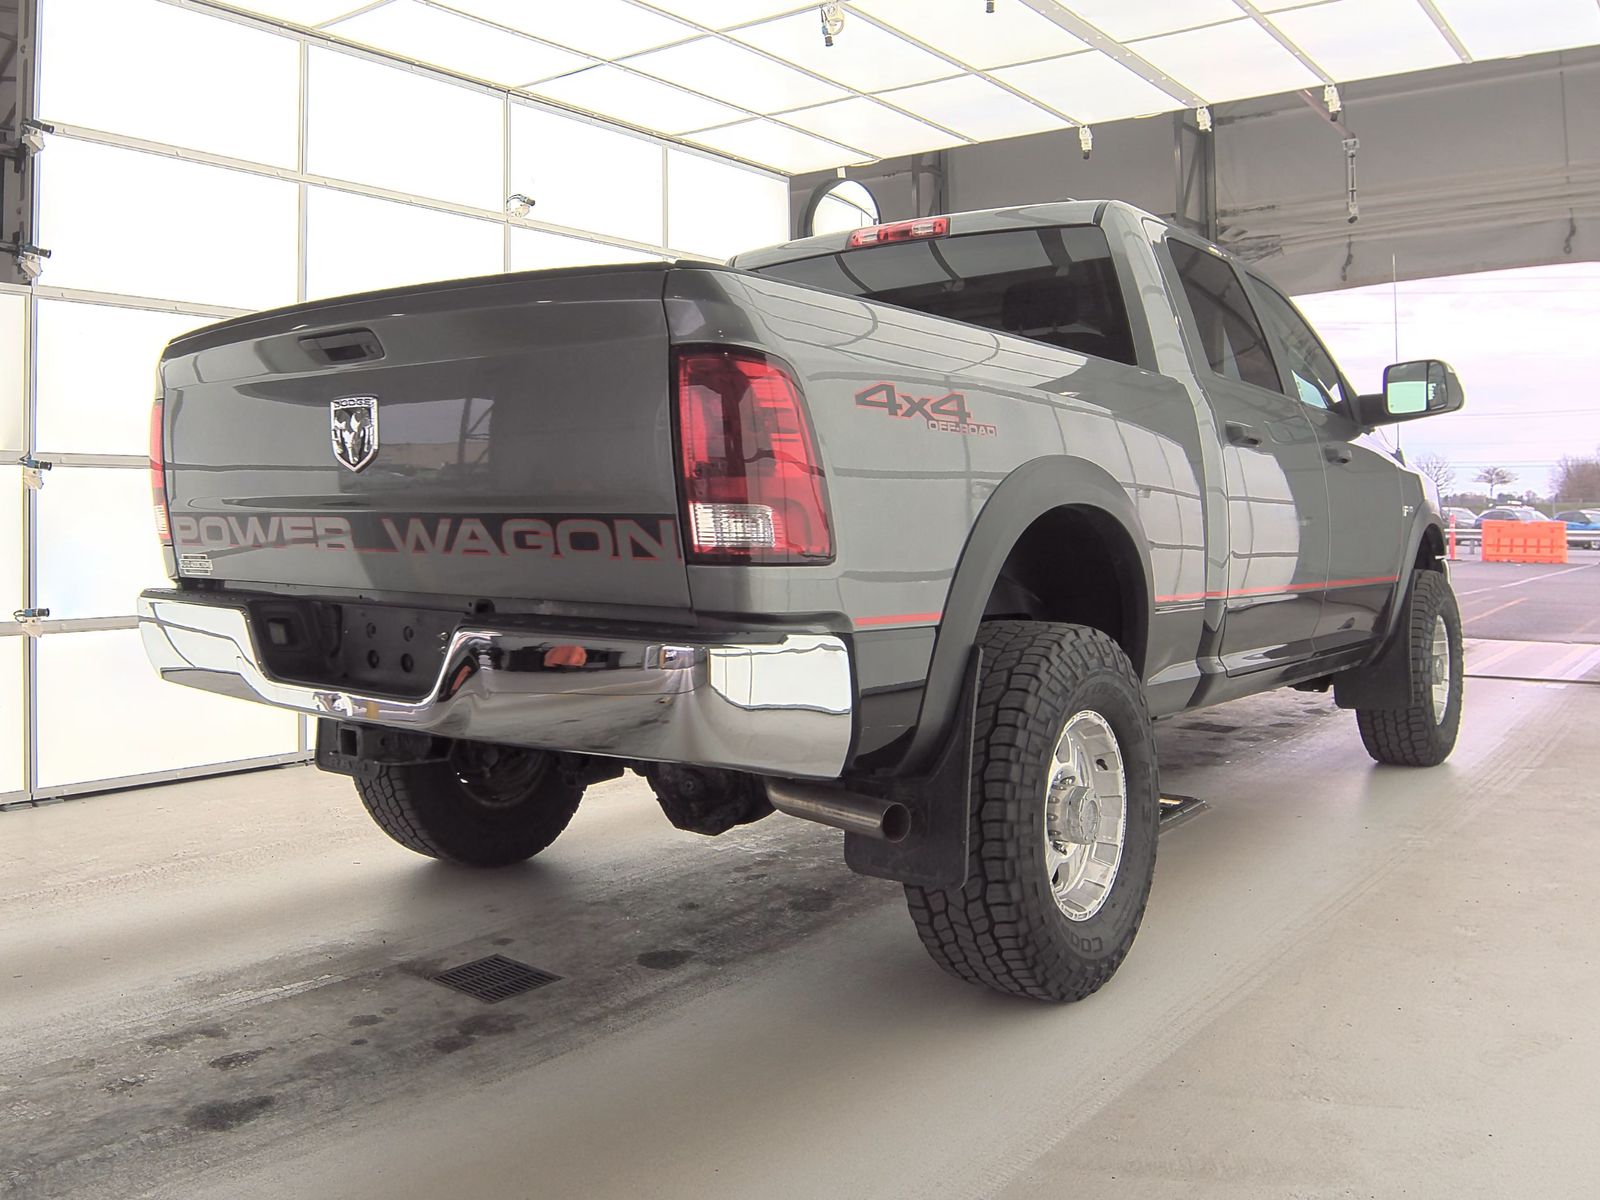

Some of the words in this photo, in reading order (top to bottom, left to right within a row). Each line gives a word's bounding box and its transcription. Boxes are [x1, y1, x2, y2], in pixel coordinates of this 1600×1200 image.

[333, 399, 373, 408] DODGE
[173, 515, 354, 551] POWER
[381, 517, 681, 561] WAGON
